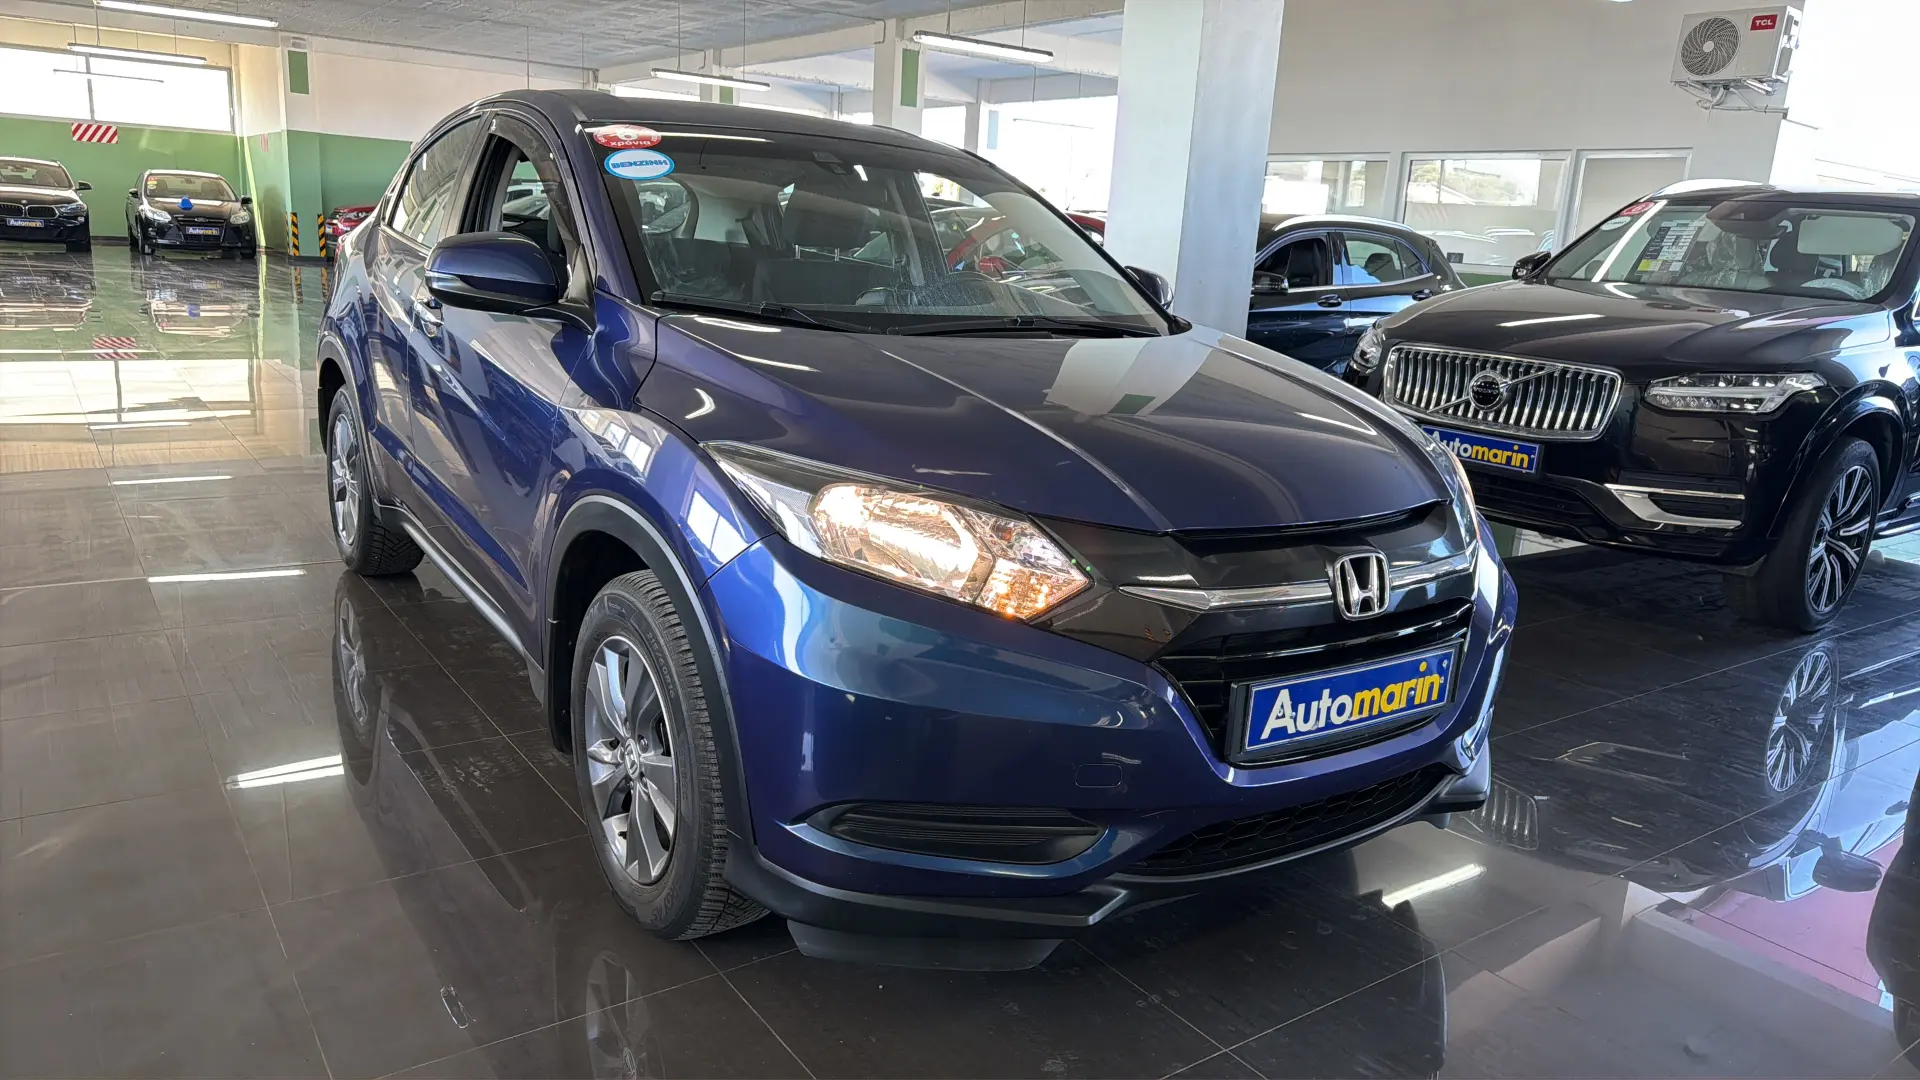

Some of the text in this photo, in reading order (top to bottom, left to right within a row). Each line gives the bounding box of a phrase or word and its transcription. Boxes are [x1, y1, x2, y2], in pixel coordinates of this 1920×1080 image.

[9, 218, 42, 226] Automarin
[188, 227, 217, 235] Automarin
[1472, 386, 1498, 395] VOLVO
[1259, 661, 1441, 740] Automarin
